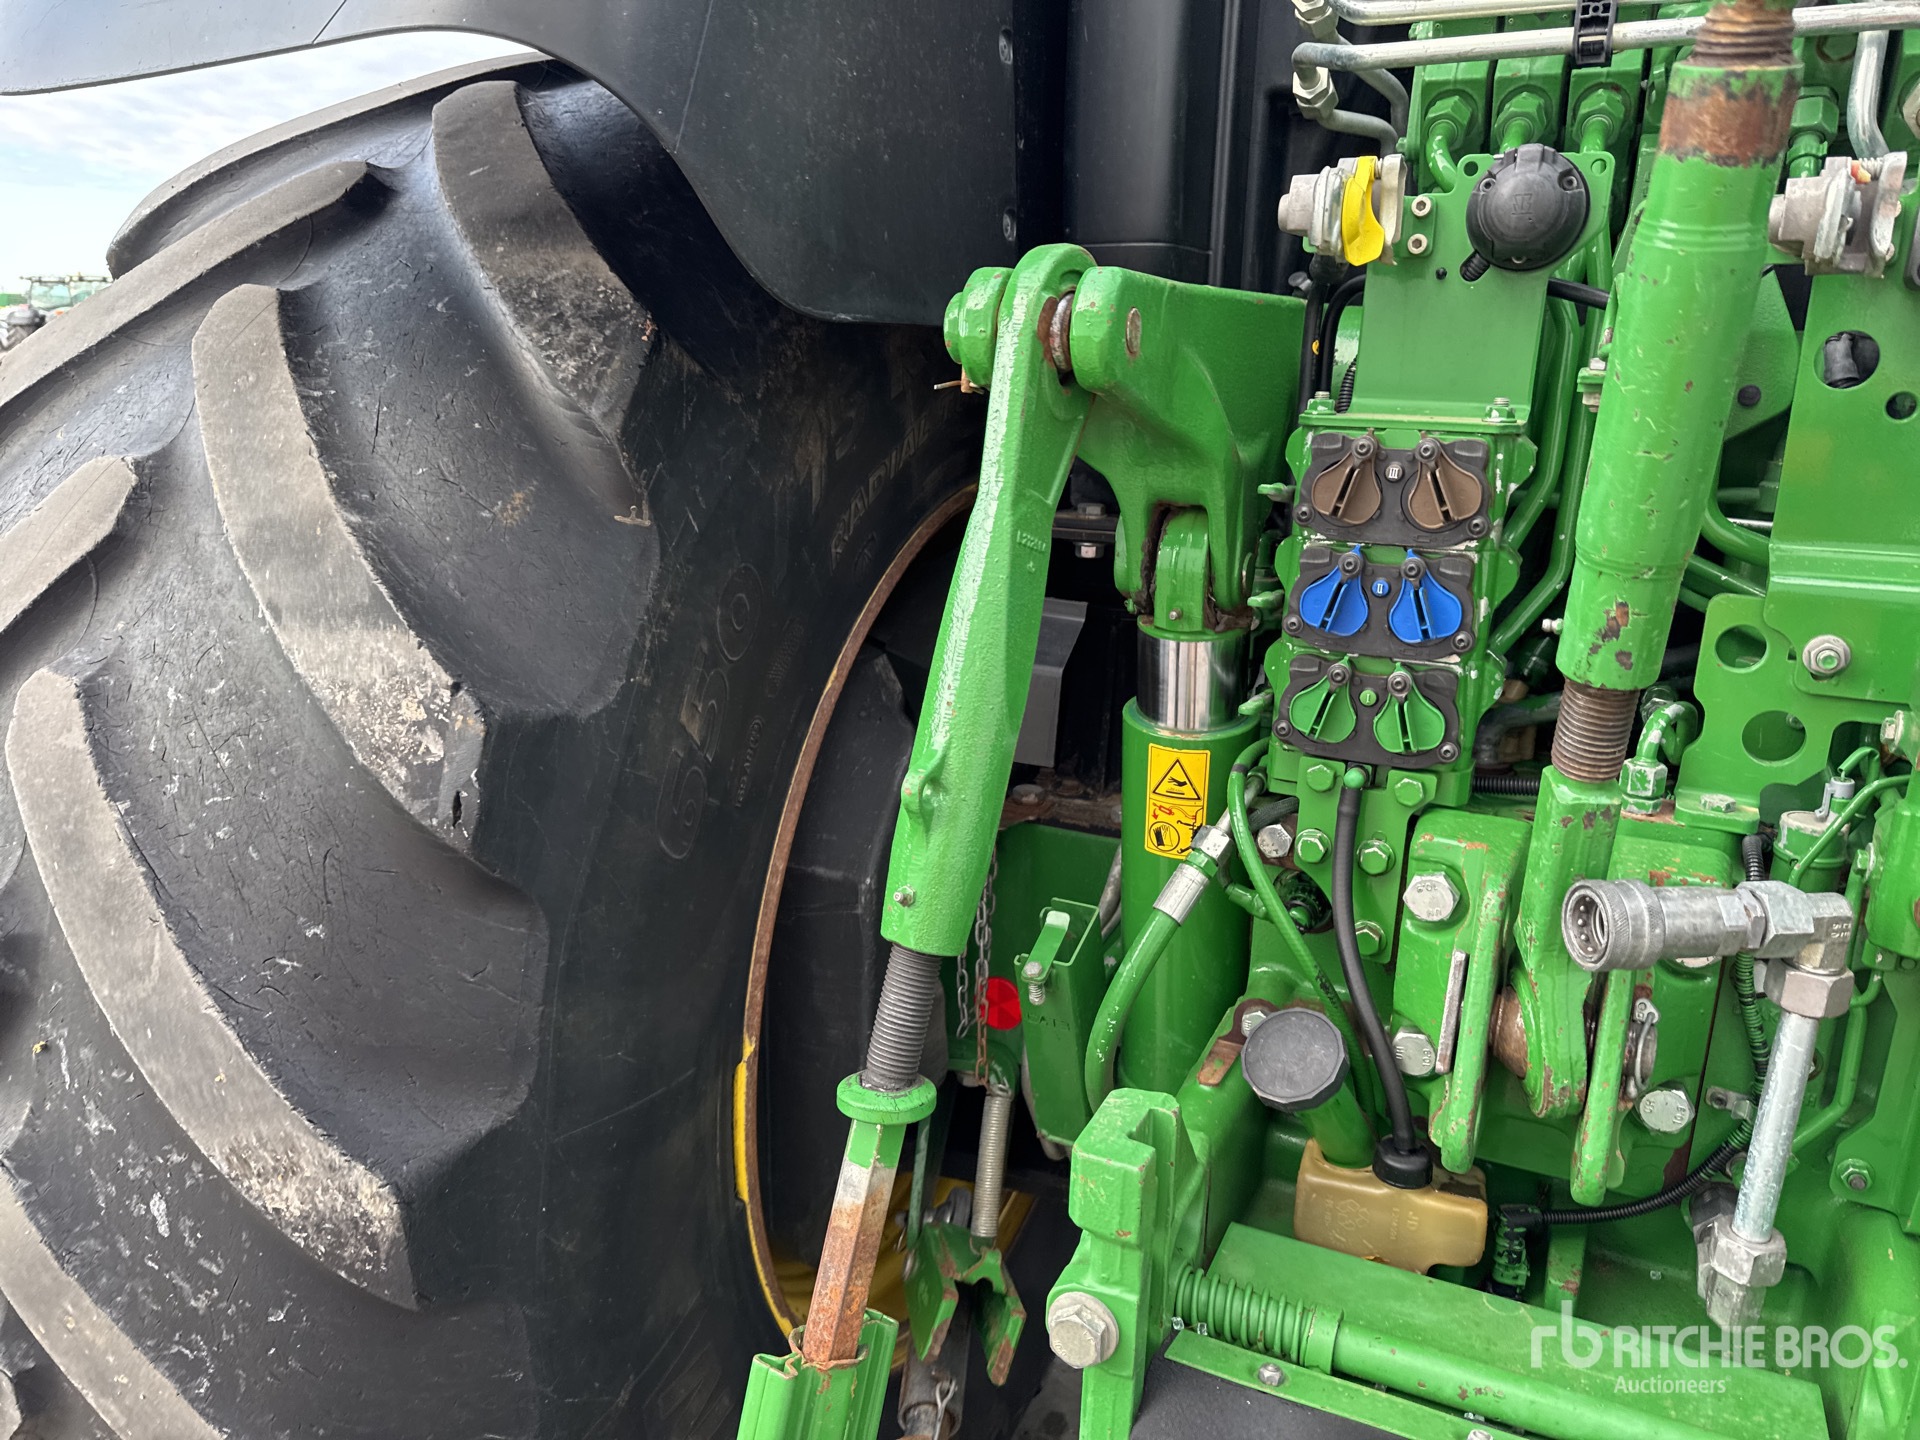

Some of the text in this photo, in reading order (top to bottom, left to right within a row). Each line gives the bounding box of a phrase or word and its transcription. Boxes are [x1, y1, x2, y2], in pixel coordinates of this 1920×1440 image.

[1388, 467, 1399, 479] III
[828, 408, 932, 578] RADIAL
[1376, 583, 1384, 594] II
